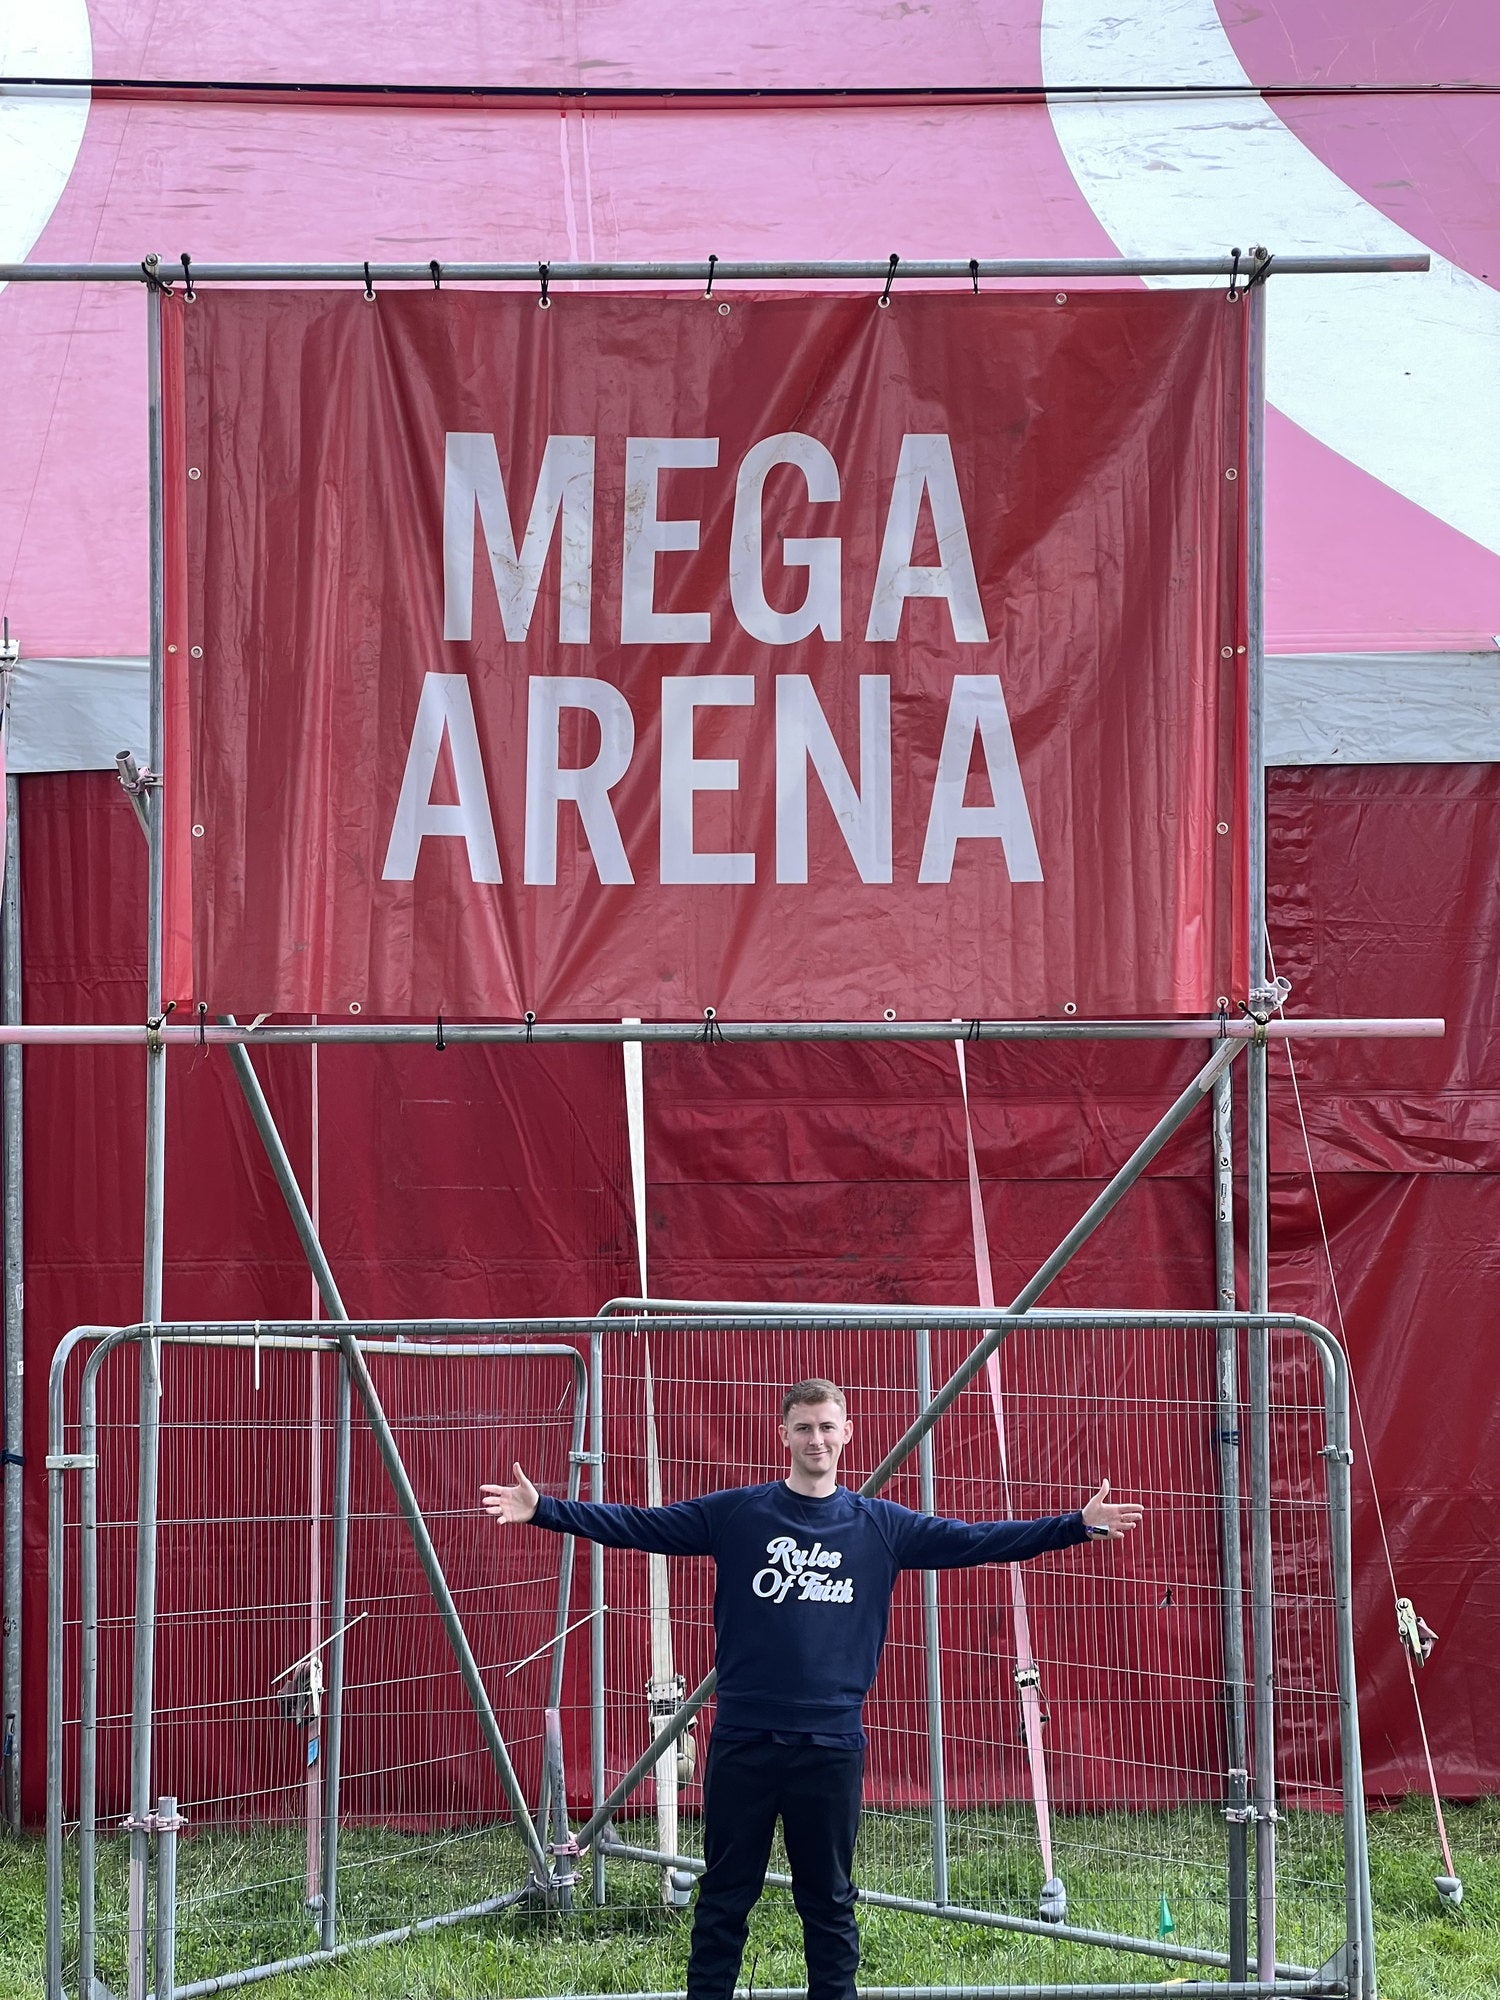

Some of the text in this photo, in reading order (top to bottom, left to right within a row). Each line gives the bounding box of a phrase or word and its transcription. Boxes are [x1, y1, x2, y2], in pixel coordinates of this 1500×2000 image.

[443, 431, 990, 646] MEGA
[381, 671, 1045, 886] ARENA
[752, 1567, 854, 1604] Of Faith
[766, 1536, 843, 1576] Rules
